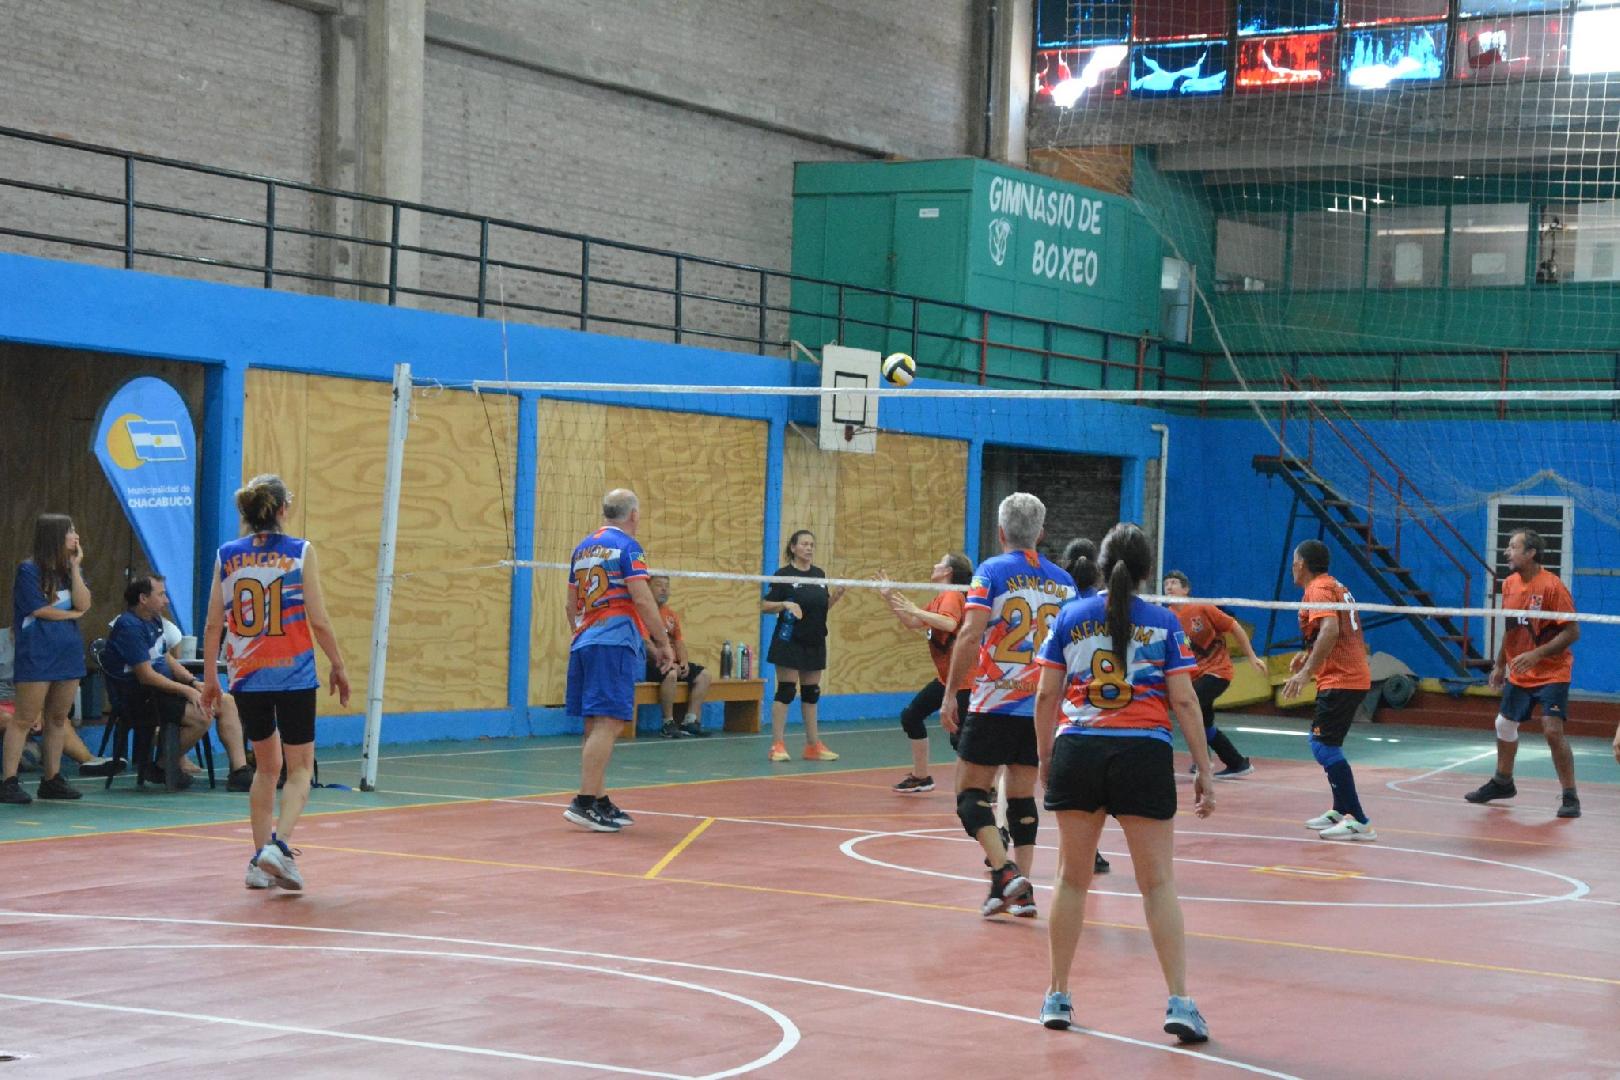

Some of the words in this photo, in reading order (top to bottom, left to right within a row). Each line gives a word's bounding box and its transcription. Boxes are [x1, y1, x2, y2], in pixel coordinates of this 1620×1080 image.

[989, 176, 1075, 229] GIMNASIO
[1078, 197, 1103, 235] DE
[1032, 239, 1098, 287] BOXEO
[127, 495, 192, 508] CHACABUCO
[223, 551, 295, 578] NEWCOM
[1006, 574, 1068, 600] NEWCOM
[232, 577, 286, 637] 01
[1087, 647, 1133, 710] 8
